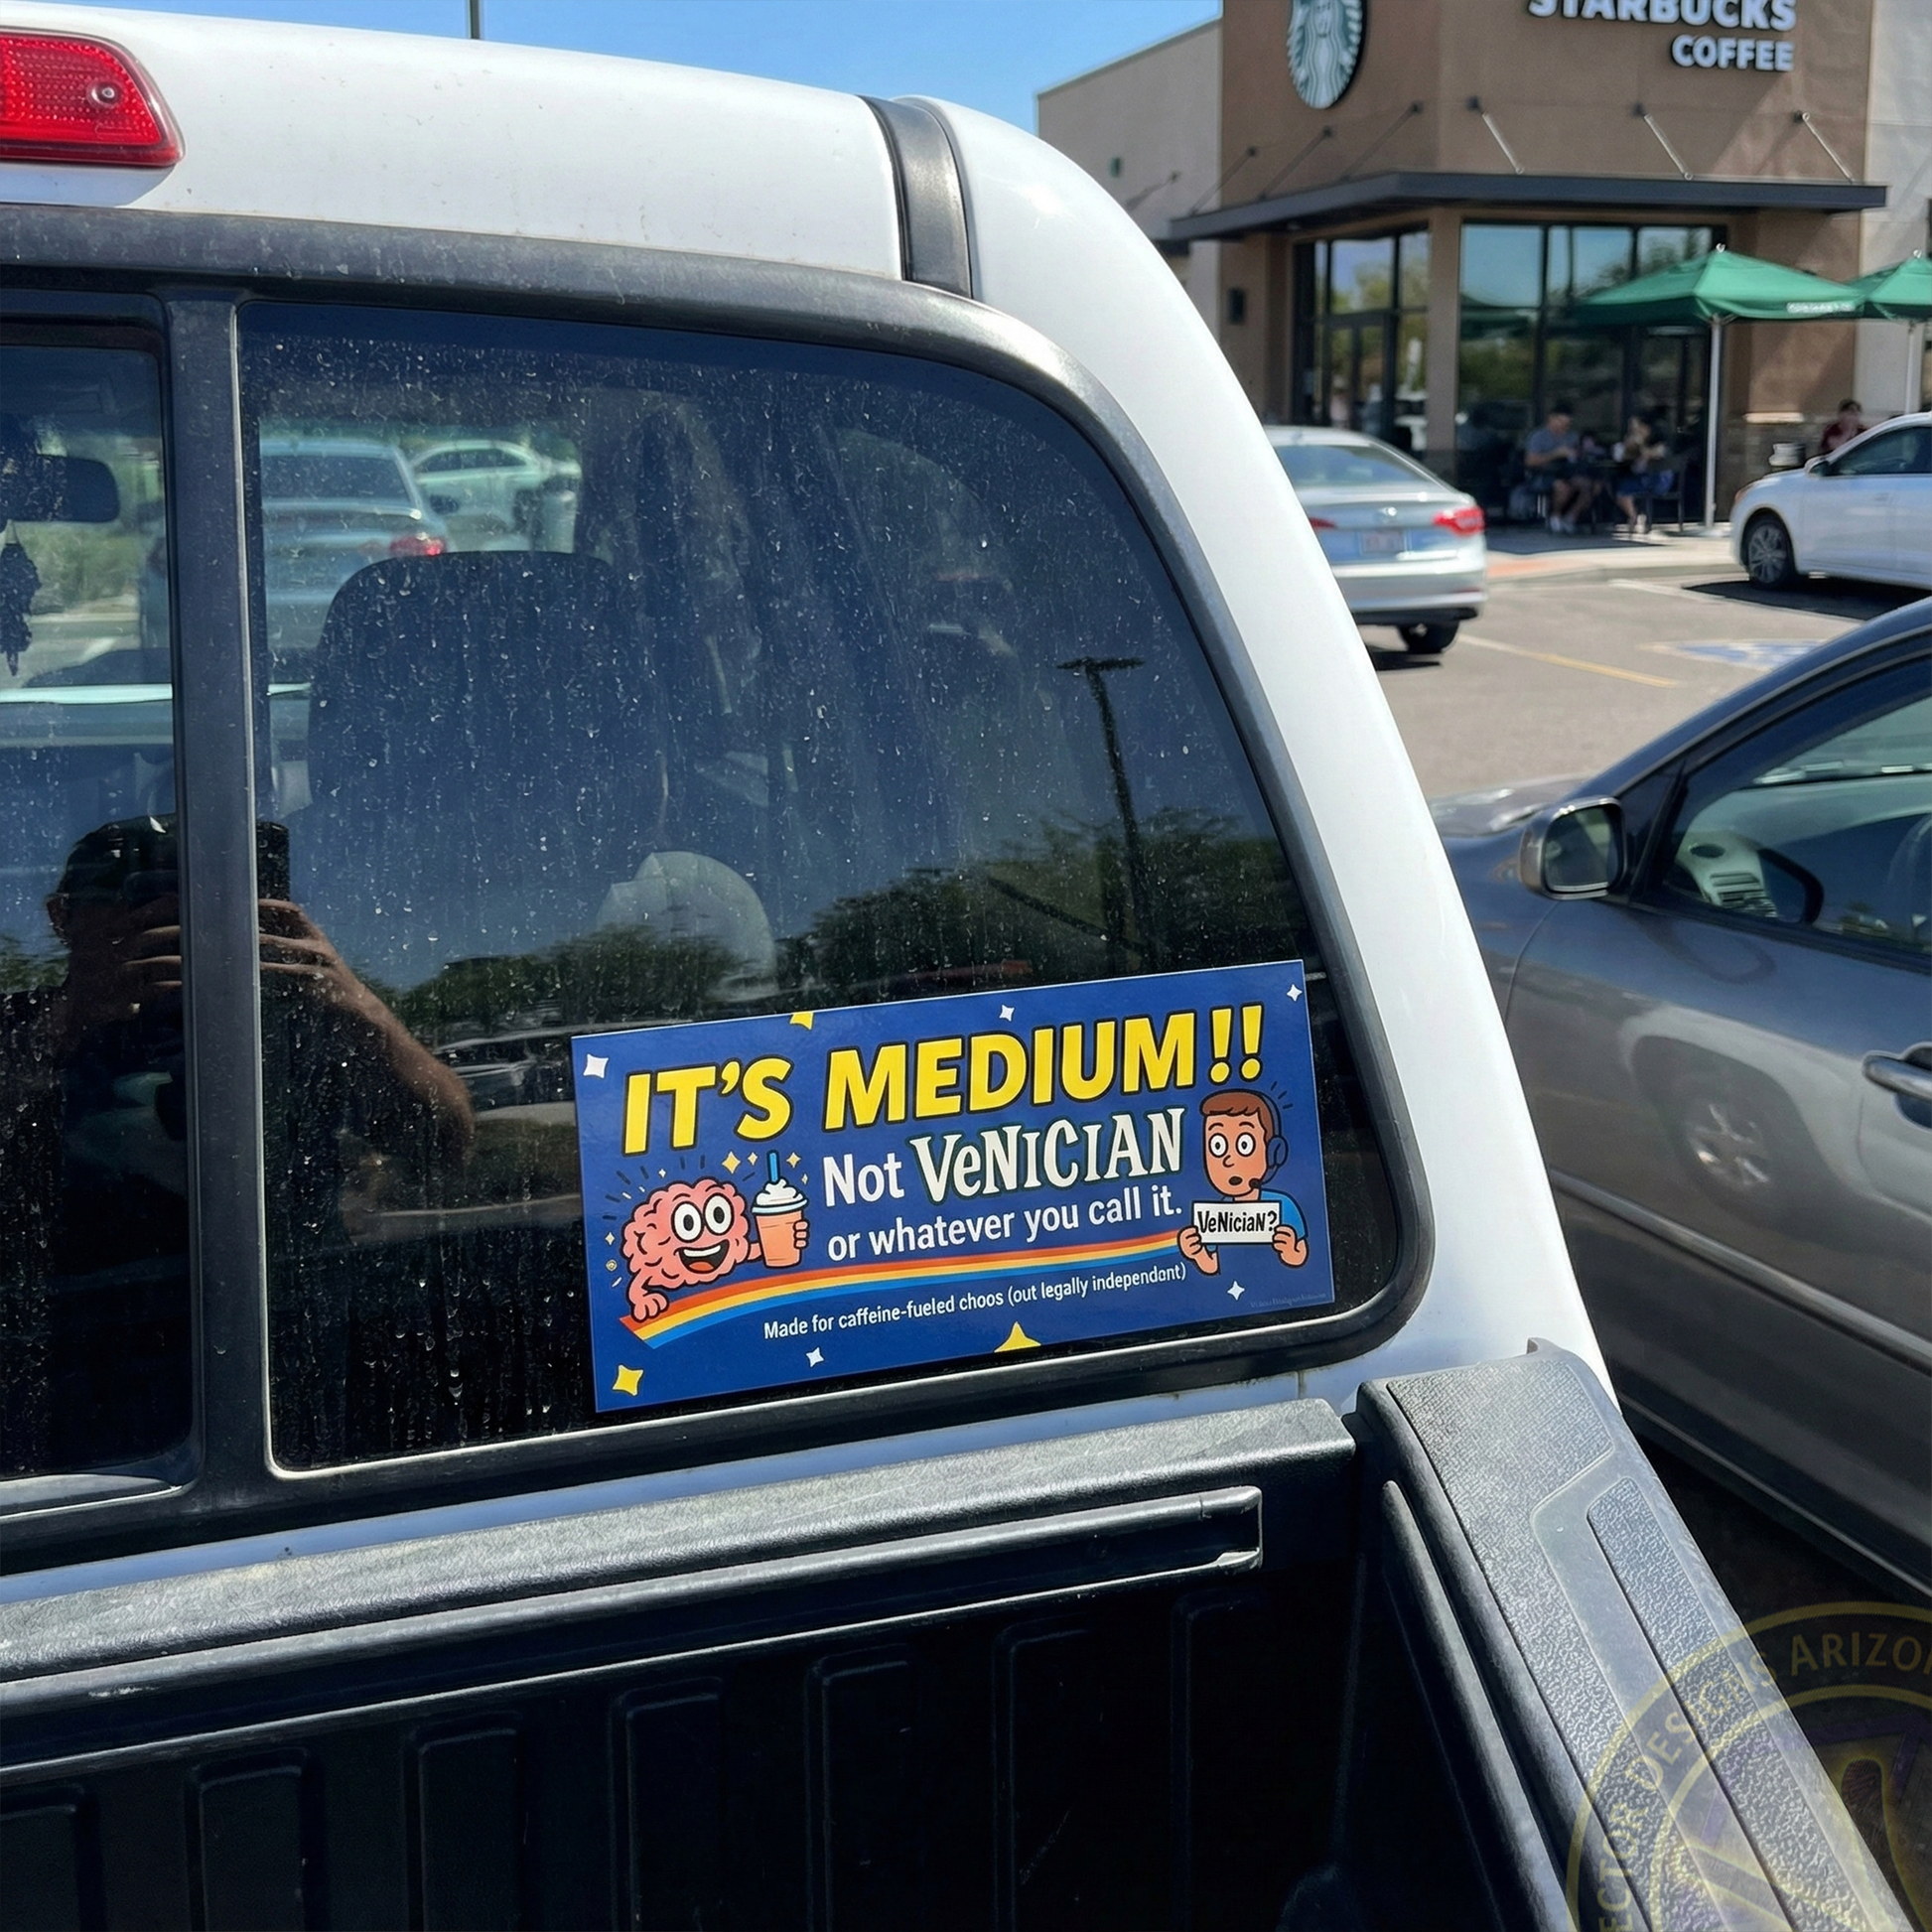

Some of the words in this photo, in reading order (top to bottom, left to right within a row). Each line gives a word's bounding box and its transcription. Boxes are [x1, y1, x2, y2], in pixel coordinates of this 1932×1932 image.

[1672, 34, 1794, 71] COFFEE
[622, 1056, 792, 1155] IT'S
[823, 1153, 905, 1207] Not
[828, 1232, 861, 1262] or
[869, 1211, 1016, 1256] whatever
[1024, 1204, 1079, 1243] you
[1088, 1185, 1142, 1226] call
[1151, 1184, 1182, 1217] it.
[763, 1317, 808, 1339] Made
[812, 1313, 834, 1332] for
[838, 1295, 955, 1329] caffeine-fueled
[1008, 1285, 1038, 1308] (out
[1040, 1276, 1089, 1302] legally
